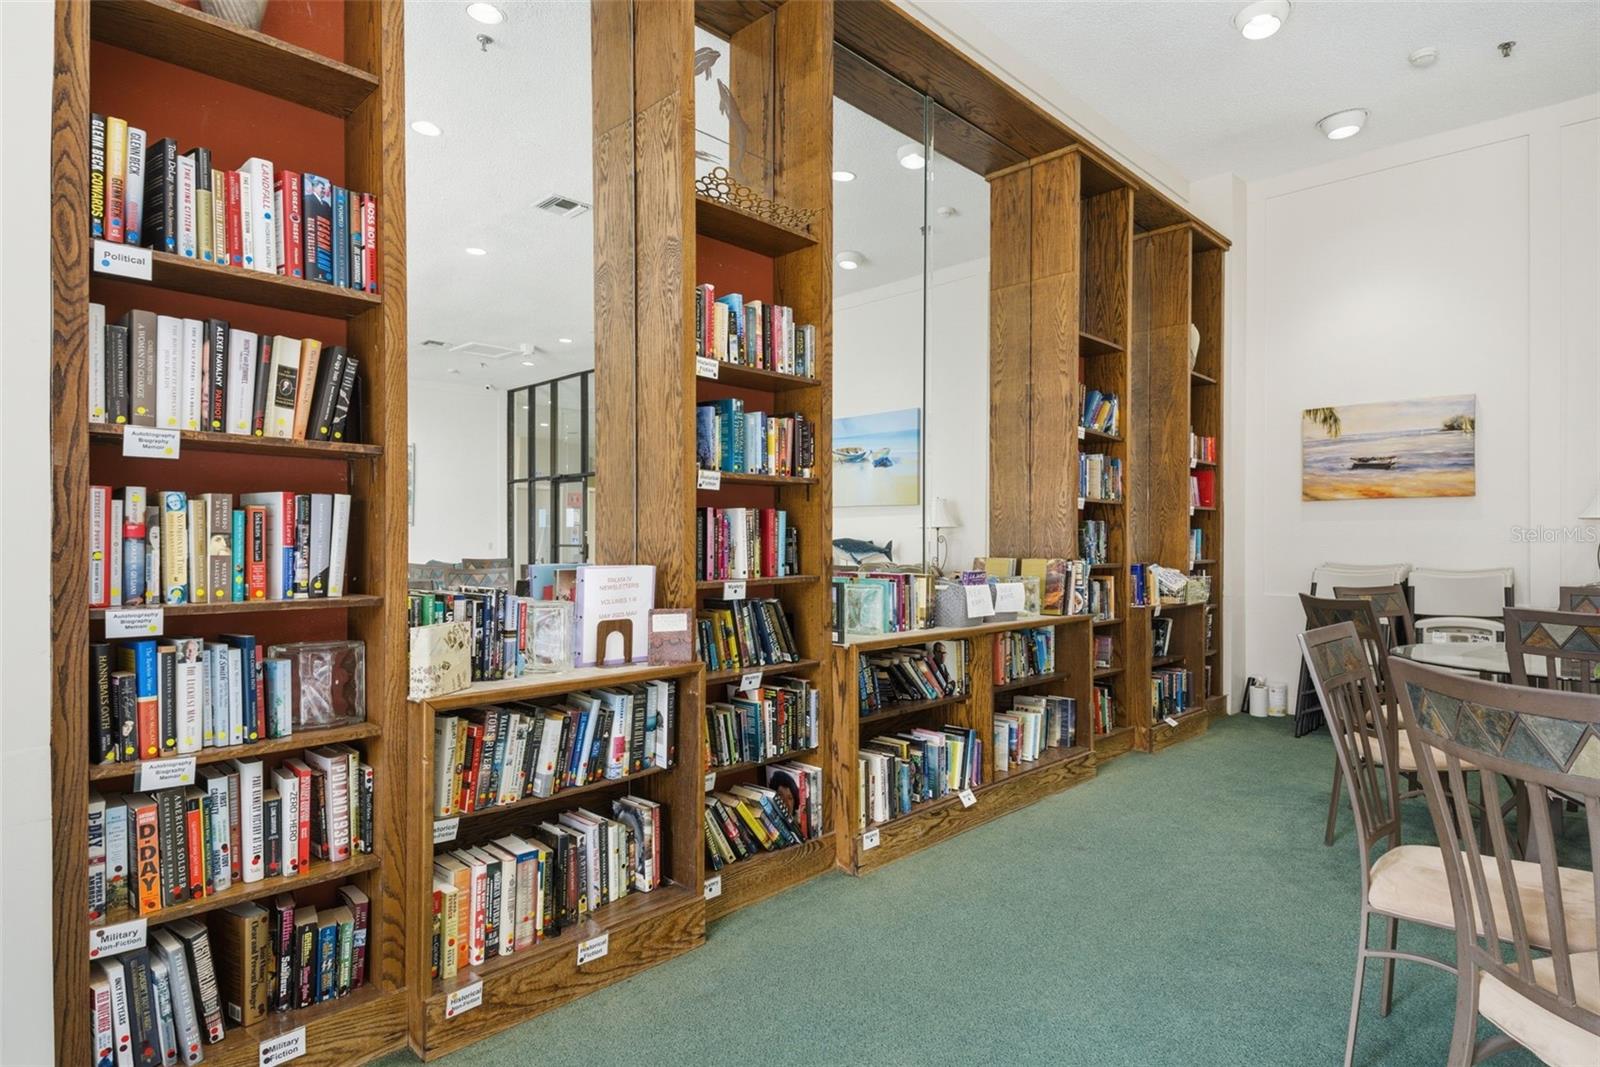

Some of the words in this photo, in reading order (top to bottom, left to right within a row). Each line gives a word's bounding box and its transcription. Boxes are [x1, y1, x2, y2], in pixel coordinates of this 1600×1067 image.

[92, 120, 104, 149] GLENN
[130, 133, 141, 156] GLENN
[92, 149, 104, 171] BECK
[168, 145, 176, 159] Tom
[129, 156, 140, 176] BECK
[166, 161, 175, 182] DeLay
[92, 173, 103, 217] COWARDS
[112, 178, 122, 199] GLENN
[261, 164, 270, 209] LANDFALL
[317, 216, 331, 272] REAGANLAND
[103, 251, 146, 267] Political
[131, 431, 176, 439] Autobiography
[99, 655, 109, 705] HANNIBAL'S
[102, 706, 110, 729] OATH
[487, 713, 497, 740] TOMS
[149, 760, 192, 770] Autobiography
[483, 742, 494, 770] RIVER
[155, 767, 186, 776] Biography
[252, 776, 261, 788] PAUL
[332, 765, 346, 814] POLAND
[252, 791, 261, 812] KENNEDY
[174, 795, 185, 845] AMERICAN
[252, 814, 262, 835] VICTORY
[334, 815, 348, 846] 1939
[139, 824, 158, 892] D-DAY
[165, 834, 173, 861] TOMMY
[253, 845, 262, 855] SEA
[177, 847, 186, 889] SOLDIER
[579, 855, 587, 893] ARTIFICE
[100, 928, 139, 944] Military
[283, 911, 293, 940] Griffin
[98, 937, 143, 952] Non-Fiction
[580, 939, 607, 954] Historical
[584, 948, 603, 960] Fiction
[192, 933, 217, 1003] WESTMORELAND
[97, 991, 109, 1003] RED
[450, 988, 482, 1005] Historical
[98, 1004, 110, 1033] NOVEMBER
[268, 1037, 300, 1054] Military
[270, 1046, 299, 1063] Fiction
